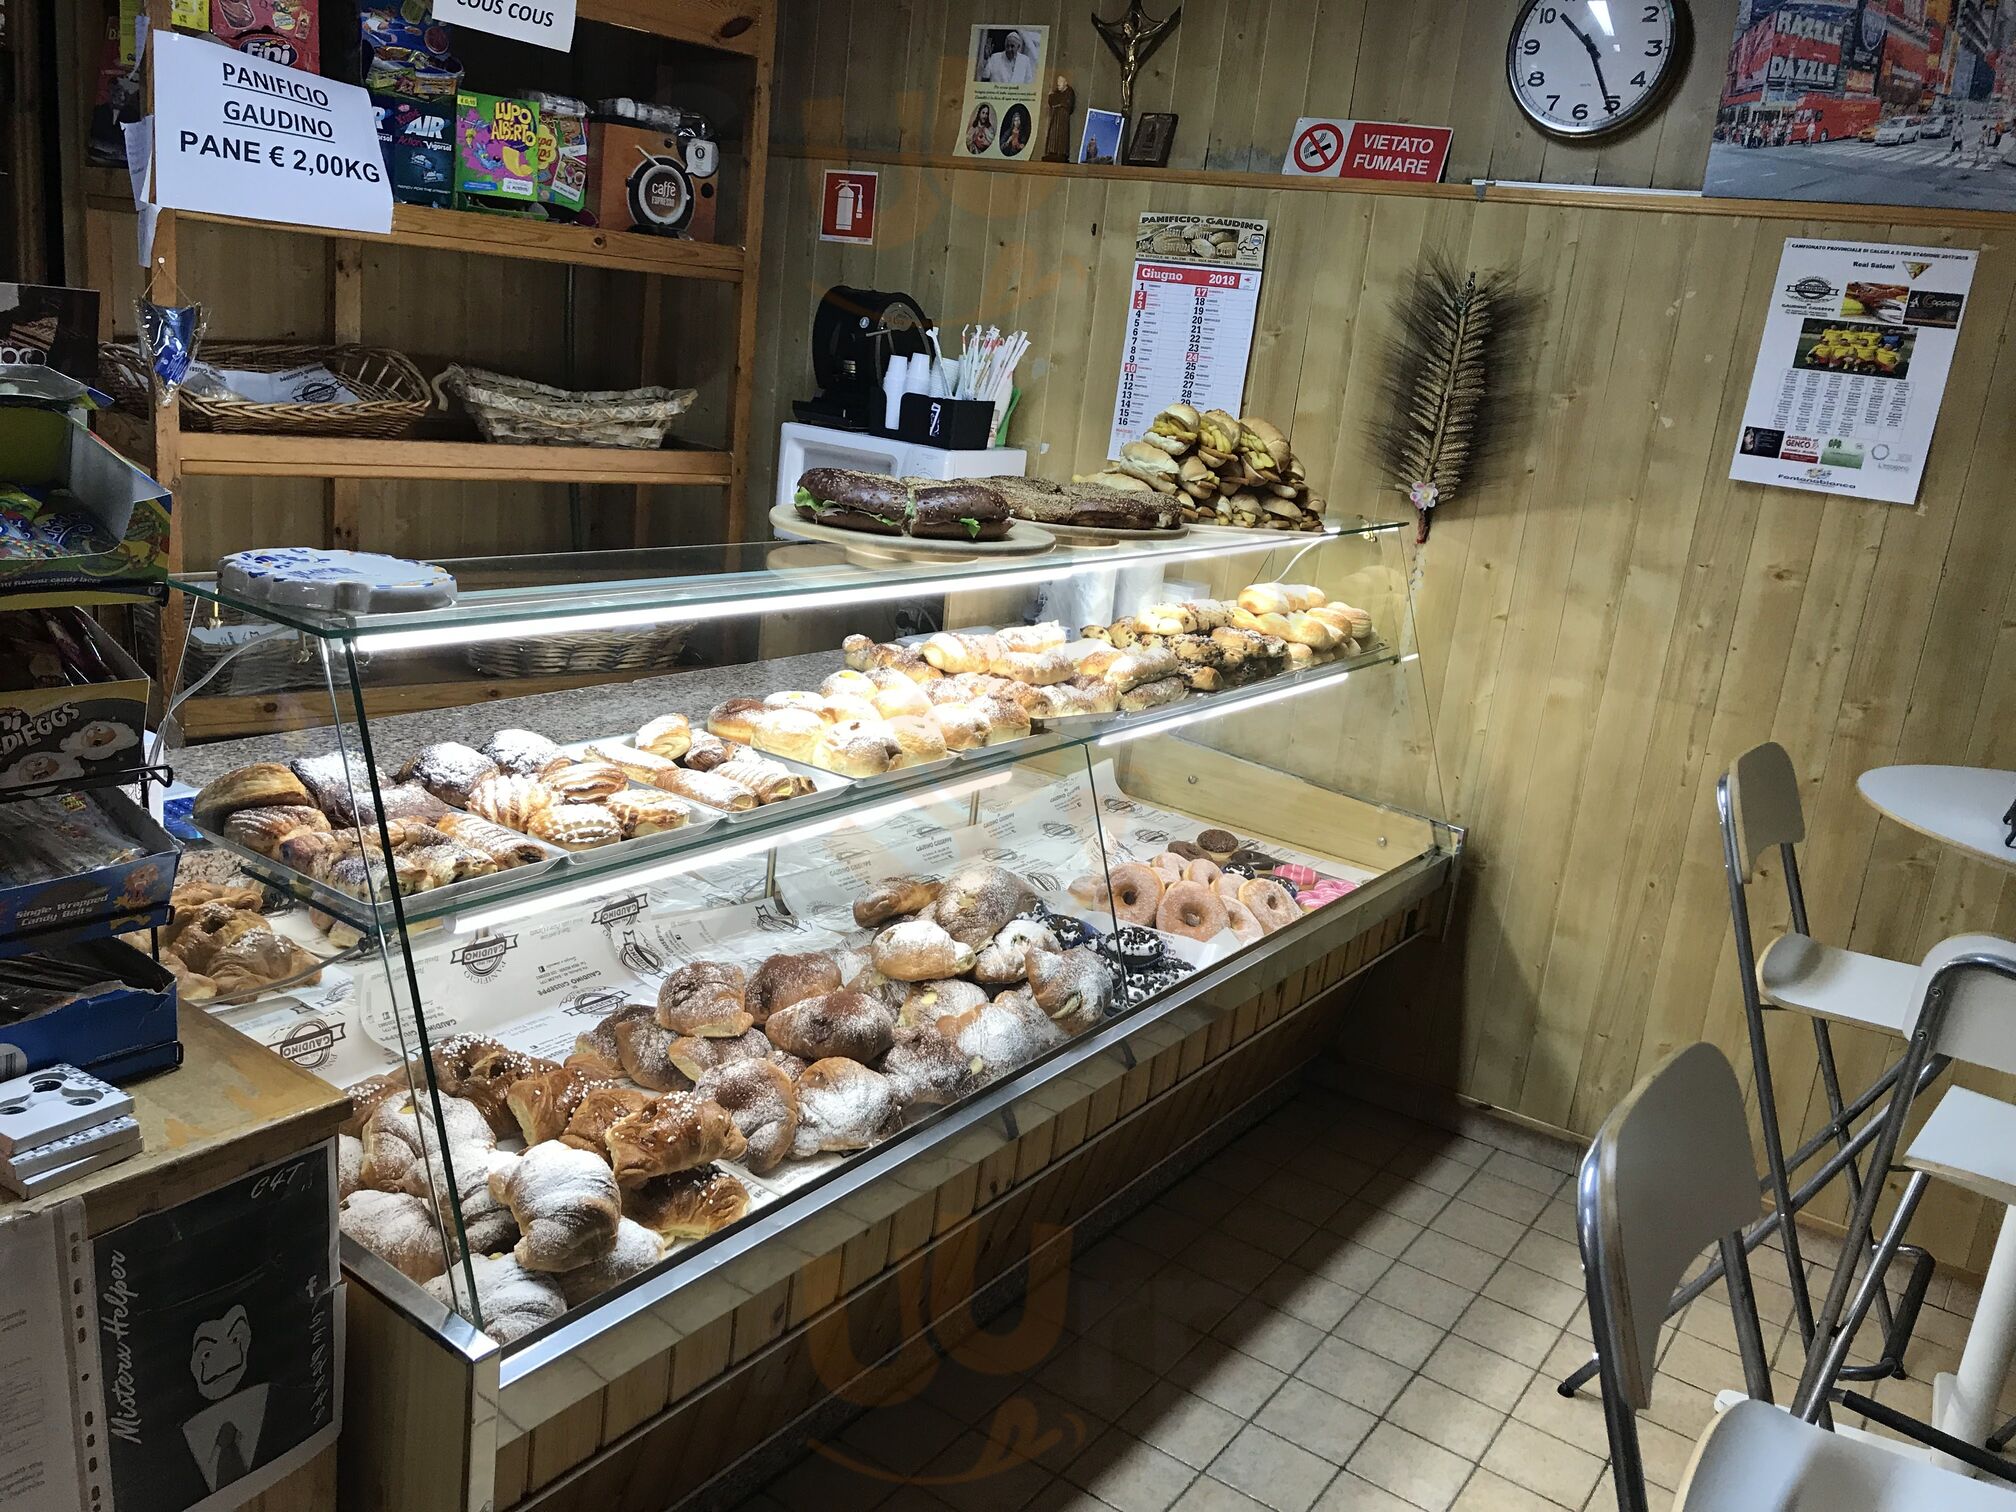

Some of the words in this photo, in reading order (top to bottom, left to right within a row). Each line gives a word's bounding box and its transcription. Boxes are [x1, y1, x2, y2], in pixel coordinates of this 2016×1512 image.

[508, 3, 555, 28] COUS
[1539, 8, 1556, 24] 10
[1642, 6, 1659, 23] 2
[1777, 11, 1844, 46] RAZZLE
[245, 43, 291, 65] Fini
[1524, 39, 1540, 55] 9
[1644, 40, 1663, 57] 3
[1769, 55, 1837, 84] DAZZLE
[222, 62, 330, 108] PANIFICIO
[1527, 71, 1545, 87] 8
[1630, 71, 1646, 87] 4
[1546, 95, 1560, 111] 7
[223, 100, 333, 139] GAUDINO
[495, 102, 531, 125] LUPO
[1572, 104, 1588, 120] 6
[404, 115, 445, 139] AIR
[491, 120, 536, 147] ALBERTO
[1364, 134, 1433, 154] VIETATO
[180, 130, 261, 164] PANE
[268, 145, 284, 168] €
[293, 149, 380, 184] 2,00KG
[1353, 154, 1430, 175] FUMARE
[652, 181, 676, 198] caffè
[1141, 215, 1201, 224] PANIFICIO
[1206, 217, 1264, 232] GAUDINO
[1853, 261, 1869, 269] Real
[1141, 269, 1183, 282] Giugno
[1208, 273, 1235, 286] 2018
[1138, 292, 1144, 300] 2
[1196, 289, 1207, 297] 17
[1195, 298, 1205, 306] 18
[1136, 310, 1141, 318] 4
[1194, 307, 1204, 315] 19
[1134, 319, 1140, 327] 5
[1192, 316, 1202, 324] 20
[1133, 328, 1138, 336] 6
[1191, 326, 1201, 334] 21
[1132, 337, 1138, 345] 7
[1190, 335, 1200, 343] 22
[1131, 346, 1136, 354] 8
[1189, 344, 1199, 352] 23
[1129, 355, 1135, 363] 9
[1187, 353, 1198, 361] 24
[1126, 364, 1135, 372] 10
[1185, 363, 1196, 371] 25
[1125, 373, 1134, 381] 11
[1184, 372, 1195, 380] 26
[1123, 382, 1133, 390] 12
[1183, 381, 1193, 389] 27
[1122, 391, 1132, 399] 13
[1181, 390, 1192, 398] 28
[1121, 400, 1131, 408] 14
[1119, 409, 1130, 417] 15
[1118, 418, 1128, 426] 16
[1786, 439, 1811, 449] GENCO
[1777, 474, 1856, 489] Fontanabianca
[16, 906, 52, 919] Single
[57, 893, 109, 911] Wrapped
[602, 904, 637, 921] GAUDINO
[21, 913, 58, 926] Candy
[62, 906, 93, 918] Belts
[464, 943, 505, 962] GAUDINO
[463, 960, 507, 985] PANIFICIO
[570, 970, 602, 984] GAUDINO
[536, 981, 571, 996] GIUSEPPE
[283, 1035, 331, 1057] GAUDINO
[101, 1250, 140, 1342] Helper
